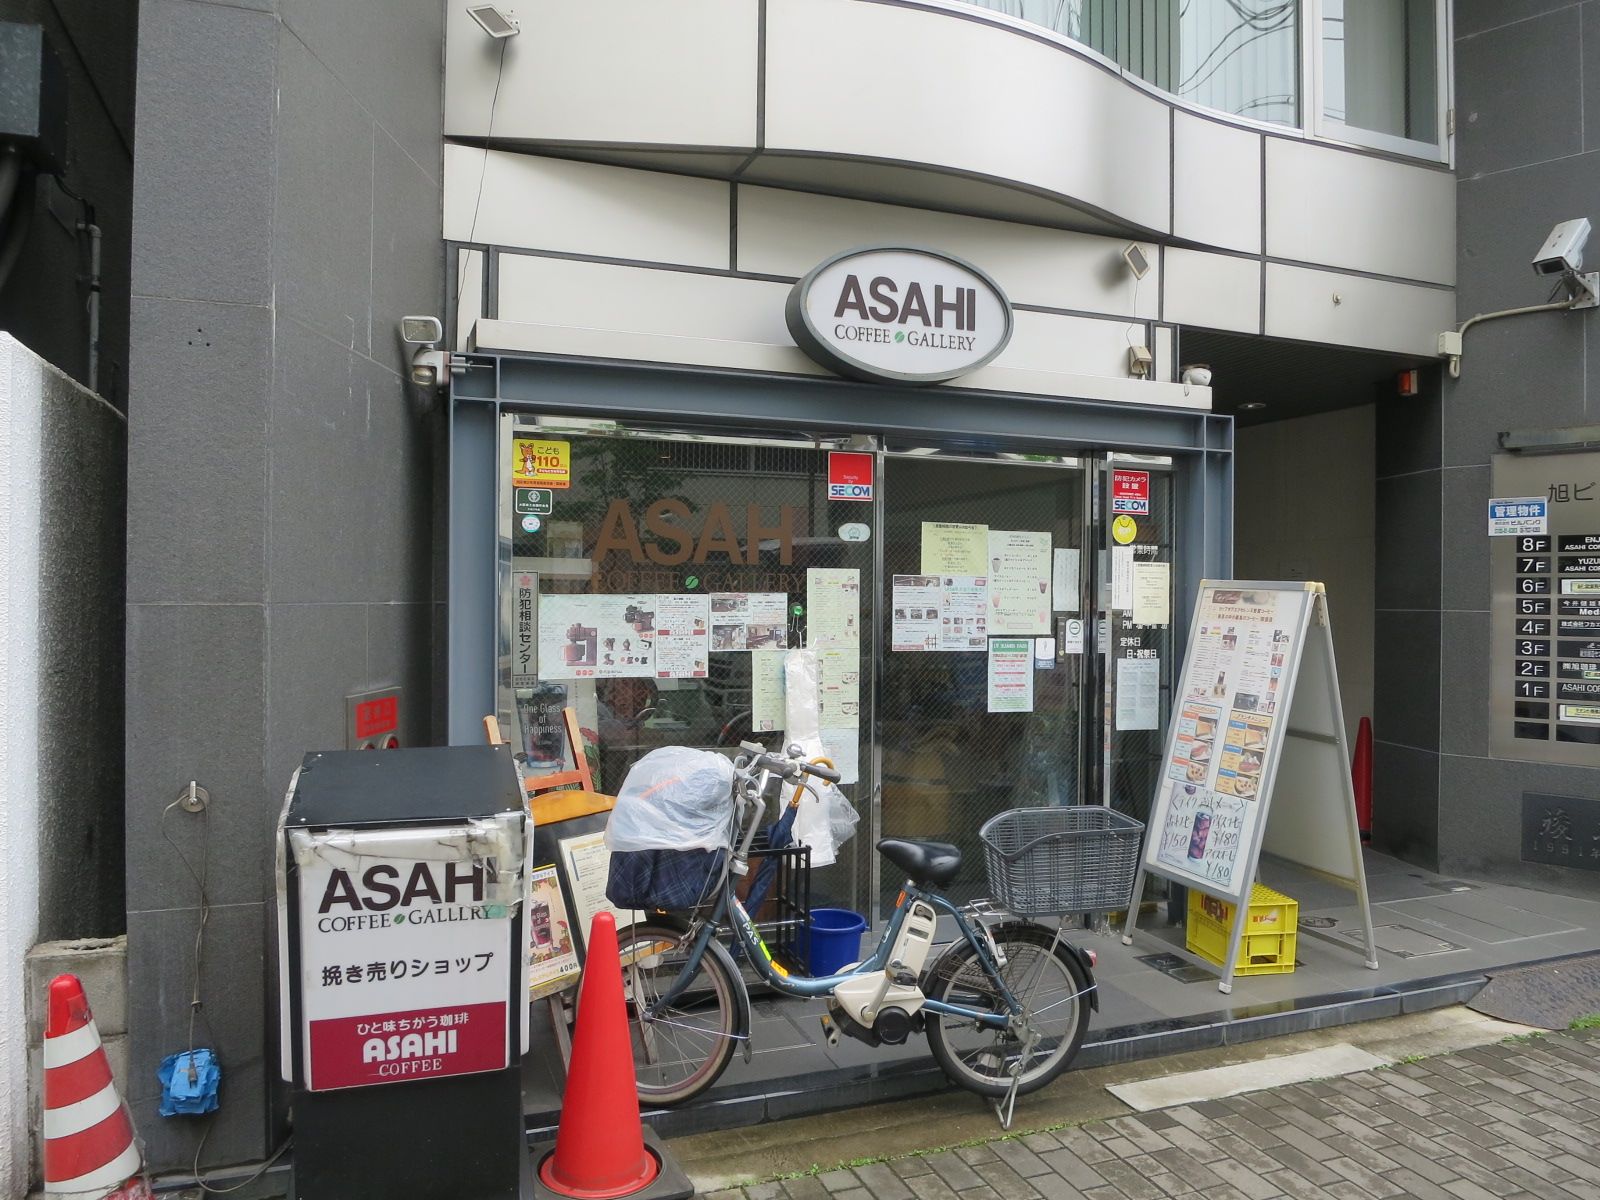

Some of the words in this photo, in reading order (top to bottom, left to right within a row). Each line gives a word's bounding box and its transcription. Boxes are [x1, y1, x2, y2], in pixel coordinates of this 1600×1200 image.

[834, 274, 976, 331] ASAHI
[834, 324, 891, 344] COFFEE
[907, 330, 976, 351] GALLERY
[537, 446, 560, 454] こども
[536, 456, 560, 468] 110
[831, 484, 870, 496] SECOM
[1114, 500, 1146, 511] SECOM
[1494, 504, 1541, 518] 管理物件
[1522, 538, 1546, 552] 8F
[1522, 558, 1546, 572] 7F
[1522, 580, 1545, 592] 6F
[1522, 600, 1545, 613] 5F
[519, 588, 531, 674] 防犯相談センター
[1122, 621, 1132, 629] PM
[1522, 620, 1544, 634] 4F
[1120, 637, 1140, 646] 定休日
[1521, 641, 1544, 654] 3F
[1521, 662, 1544, 676] 2F
[1522, 682, 1544, 696] 1F
[318, 913, 391, 933] COFFEE
[742, 922, 759, 946] PAS
[322, 952, 494, 986] 挽き売りショップ
[357, 1012, 469, 1035] ひと味ちがう珈琲
[363, 1030, 457, 1063] ASAHI
[379, 1058, 442, 1076] COFFEE
